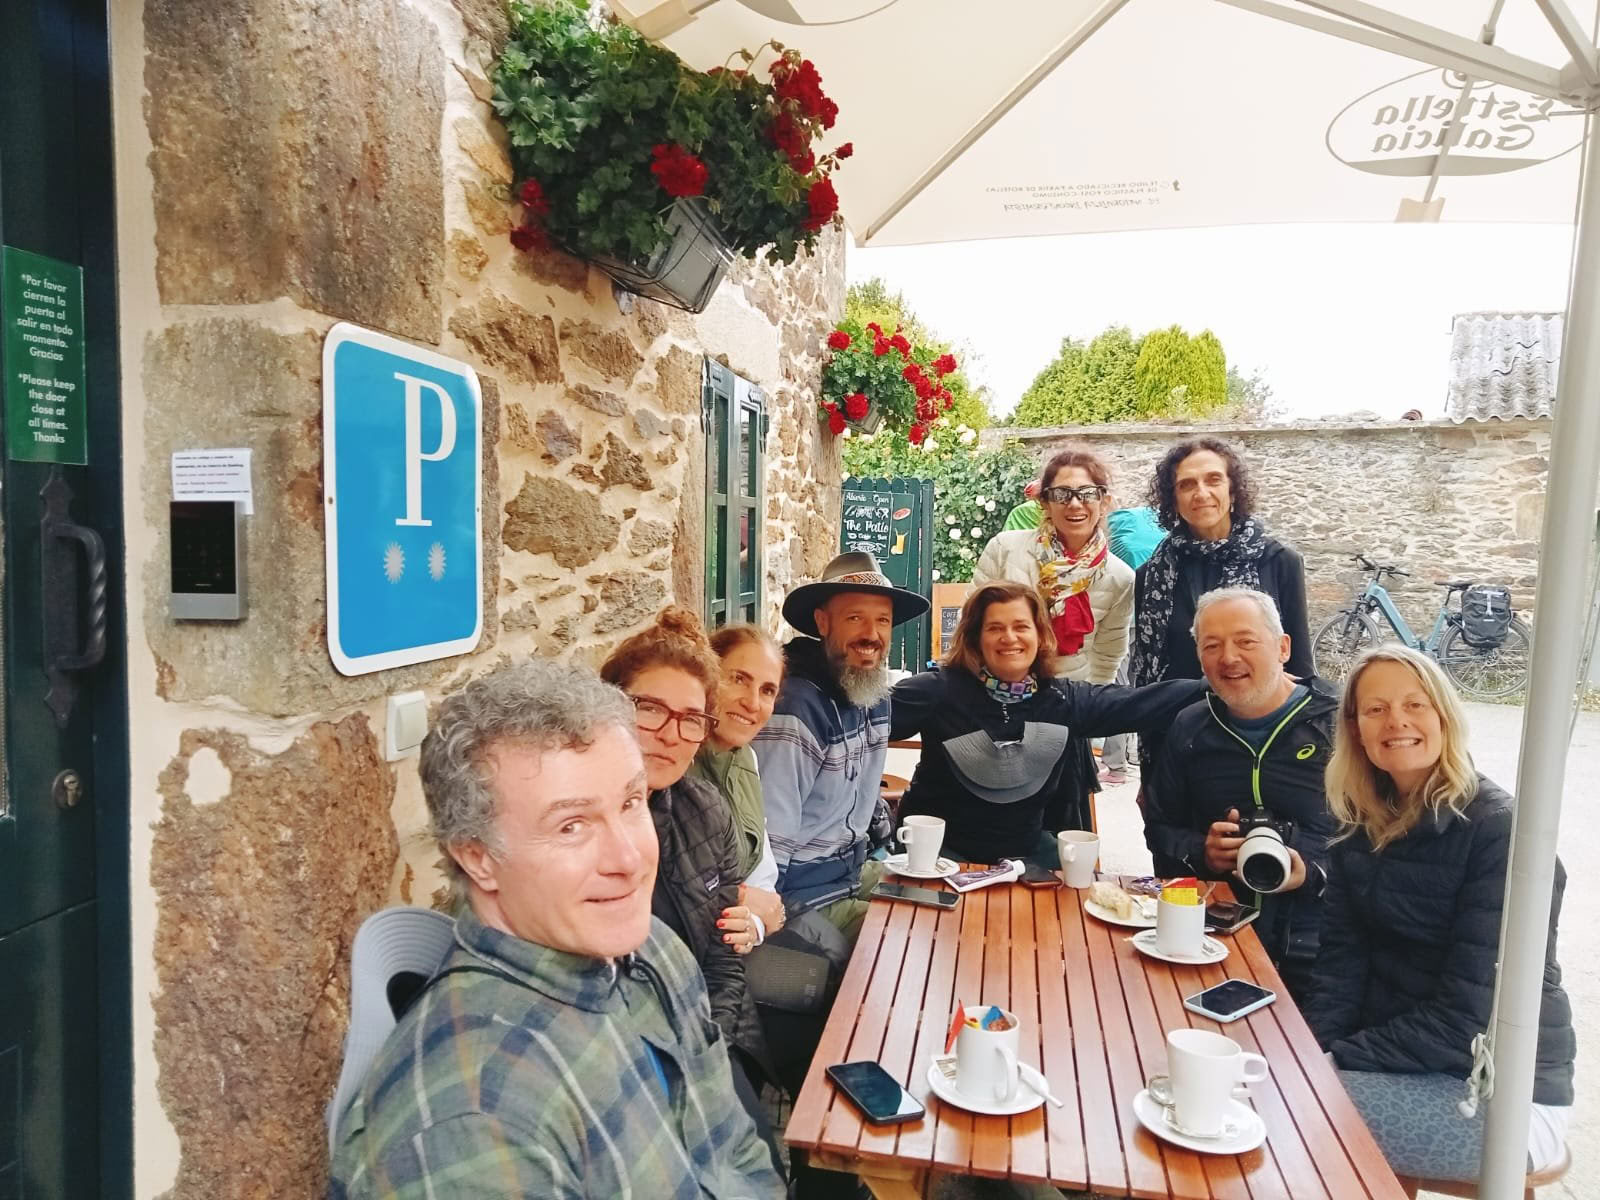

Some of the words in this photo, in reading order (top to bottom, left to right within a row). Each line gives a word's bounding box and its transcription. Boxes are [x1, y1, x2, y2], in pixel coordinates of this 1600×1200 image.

[43, 278, 67, 293] favor
[23, 289, 55, 305] cierren
[57, 295, 66, 307] la
[24, 305, 55, 318] puerta
[57, 310, 66, 320] al
[17, 317, 38, 328] salir
[39, 322, 52, 332] en
[53, 324, 74, 336] todo
[23, 333, 69, 348] momento.
[29, 346, 64, 361] Gracias
[54, 377, 76, 392] keep
[28, 388, 44, 400] the
[45, 390, 67, 403] door
[31, 403, 54, 416] close
[56, 407, 66, 416] at
[28, 416, 40, 428] all
[42, 418, 69, 430] times.
[33, 431, 66, 444] Thanks
[394, 371, 457, 527] P
[872, 494, 889, 506] Open
[843, 519, 862, 531] The
[865, 520, 889, 533] Patio
